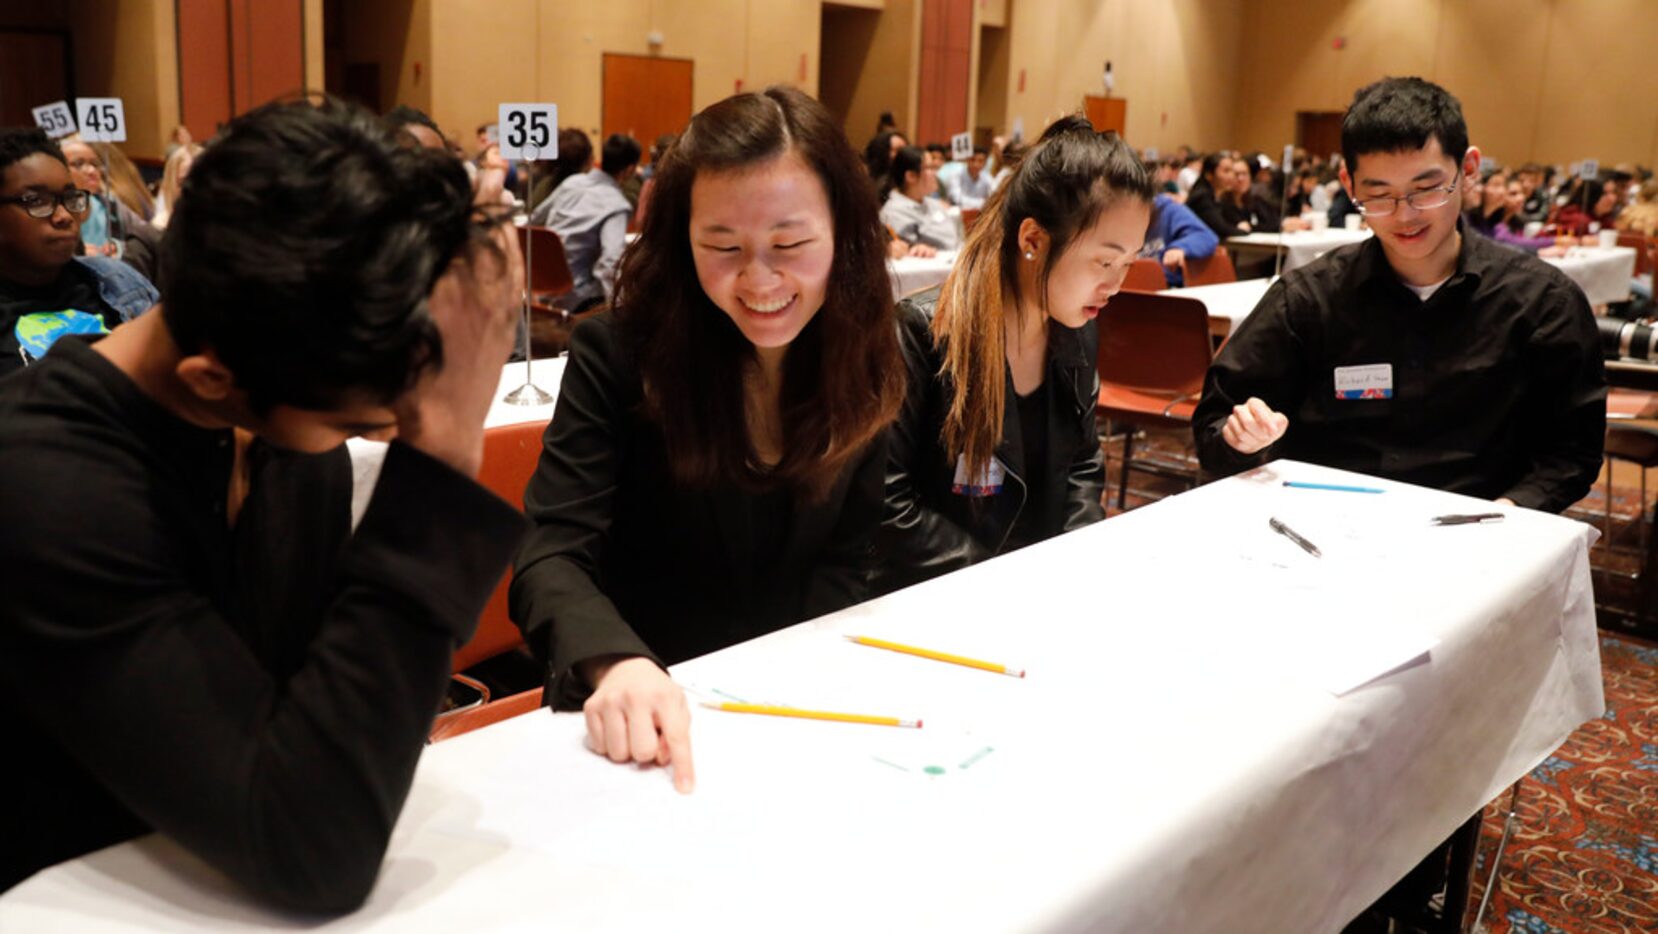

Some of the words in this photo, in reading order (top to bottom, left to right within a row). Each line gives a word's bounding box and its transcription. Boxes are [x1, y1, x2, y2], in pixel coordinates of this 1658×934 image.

[39, 107, 68, 131] 55
[85, 104, 118, 132] 45
[507, 110, 550, 149] 35
